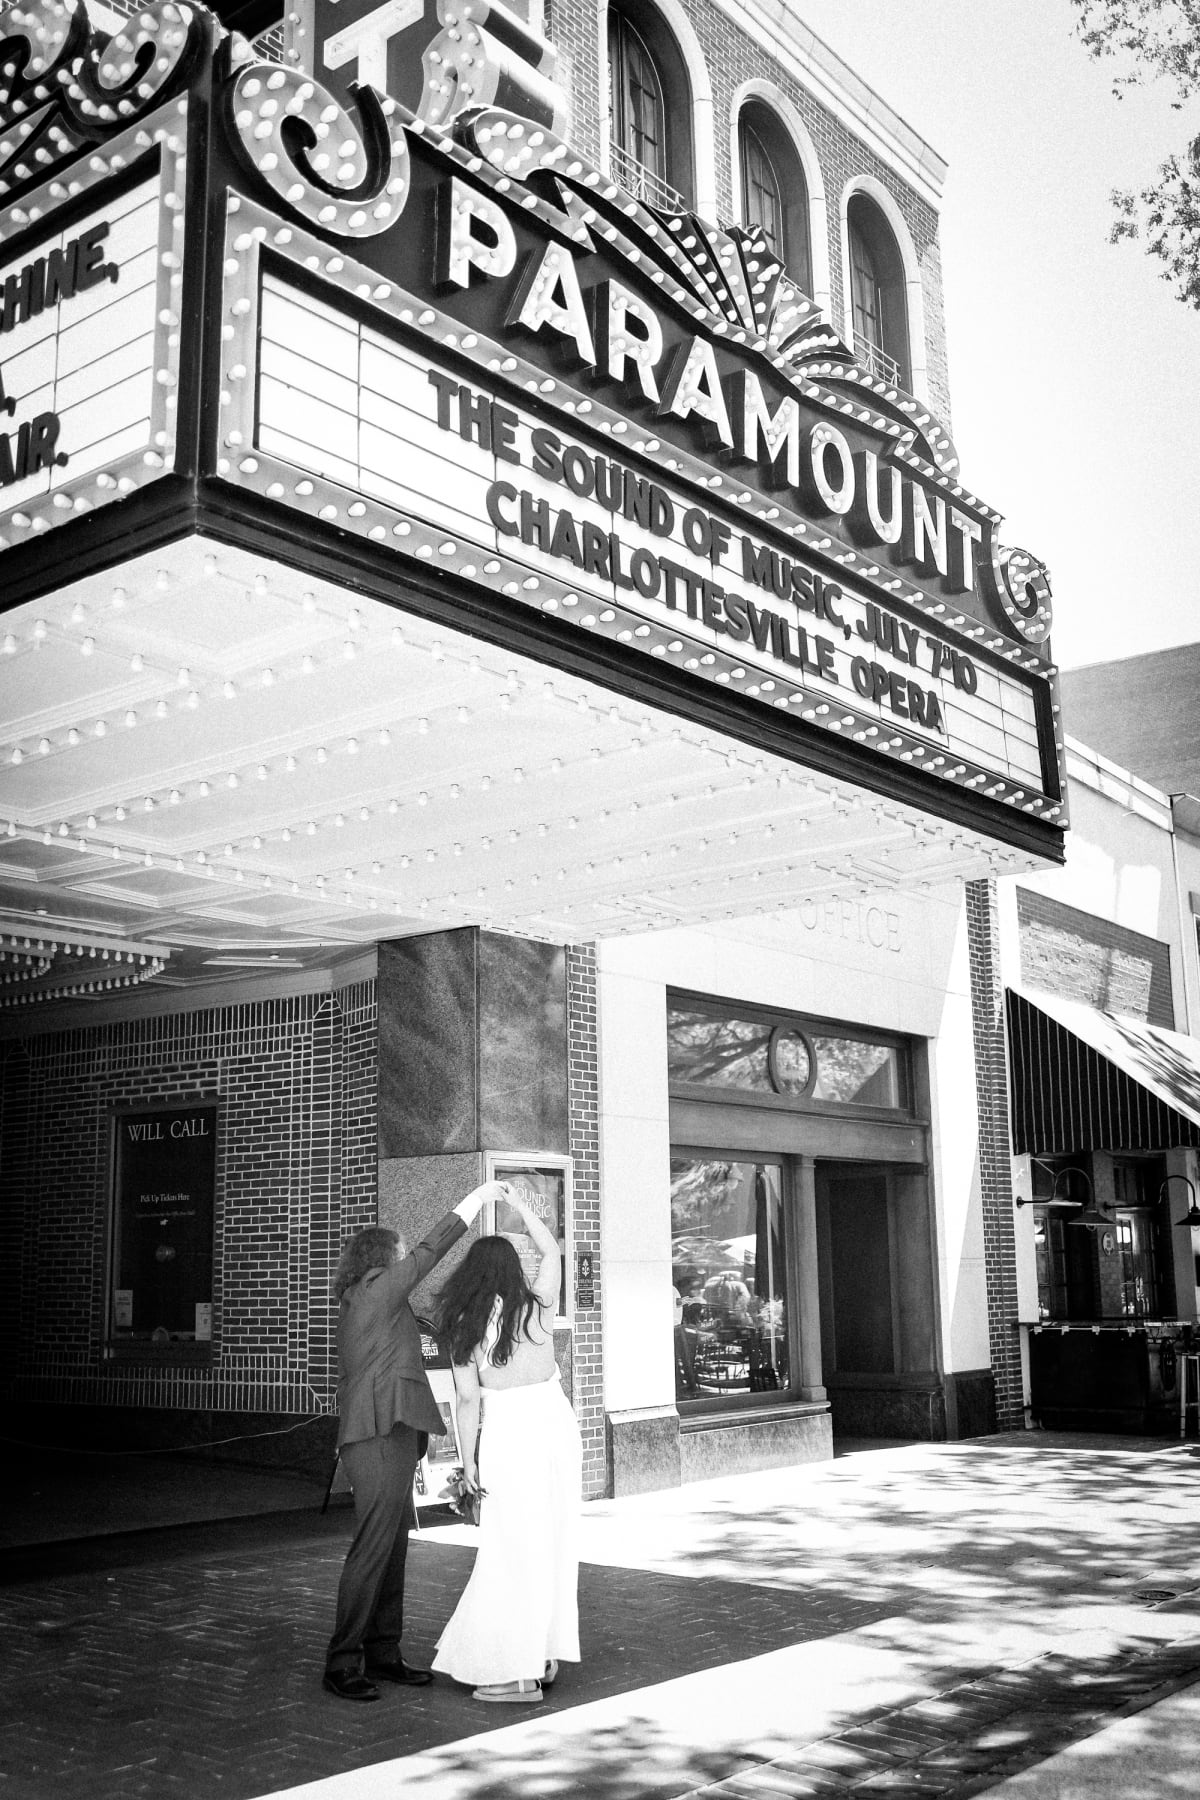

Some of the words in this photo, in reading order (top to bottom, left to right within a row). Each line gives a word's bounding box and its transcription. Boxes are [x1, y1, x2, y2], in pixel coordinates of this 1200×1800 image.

[0, 221, 119, 333] HINE,
[444, 175, 982, 592] PARAMOUNT
[428, 368, 520, 466] THE
[530, 427, 675, 538] SOUND
[682, 507, 732, 566] OF
[741, 535, 852, 641] MUSIC,
[855, 602, 920, 668] JULY
[485, 480, 839, 685] CHARLOTTESVILLE
[850, 655, 946, 736] OPERA
[127, 1122, 164, 1141] WILL
[170, 1118, 209, 1138] CALL
[516, 1187, 546, 1207] OUND
